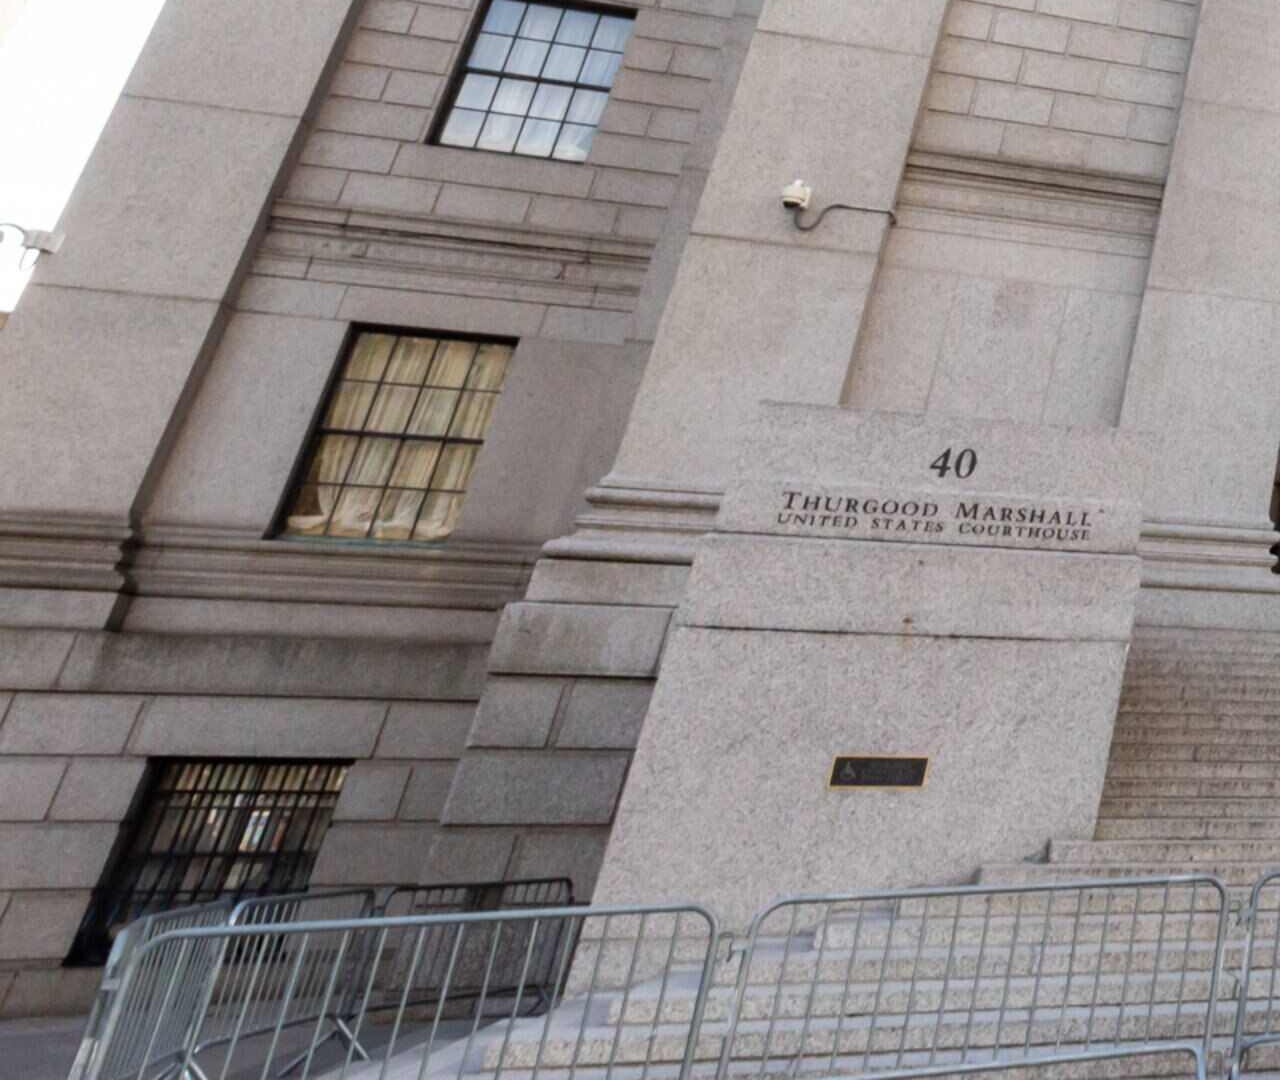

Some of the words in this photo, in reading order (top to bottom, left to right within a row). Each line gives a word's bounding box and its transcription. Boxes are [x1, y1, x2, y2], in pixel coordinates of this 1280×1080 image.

[930, 448, 977, 478] 40
[781, 491, 939, 517] THURGOOD
[954, 502, 1092, 526] MARSHALL
[777, 512, 858, 529] UNITED
[870, 517, 944, 534] STATES
[958, 522, 1091, 541] COURTHOUSE
